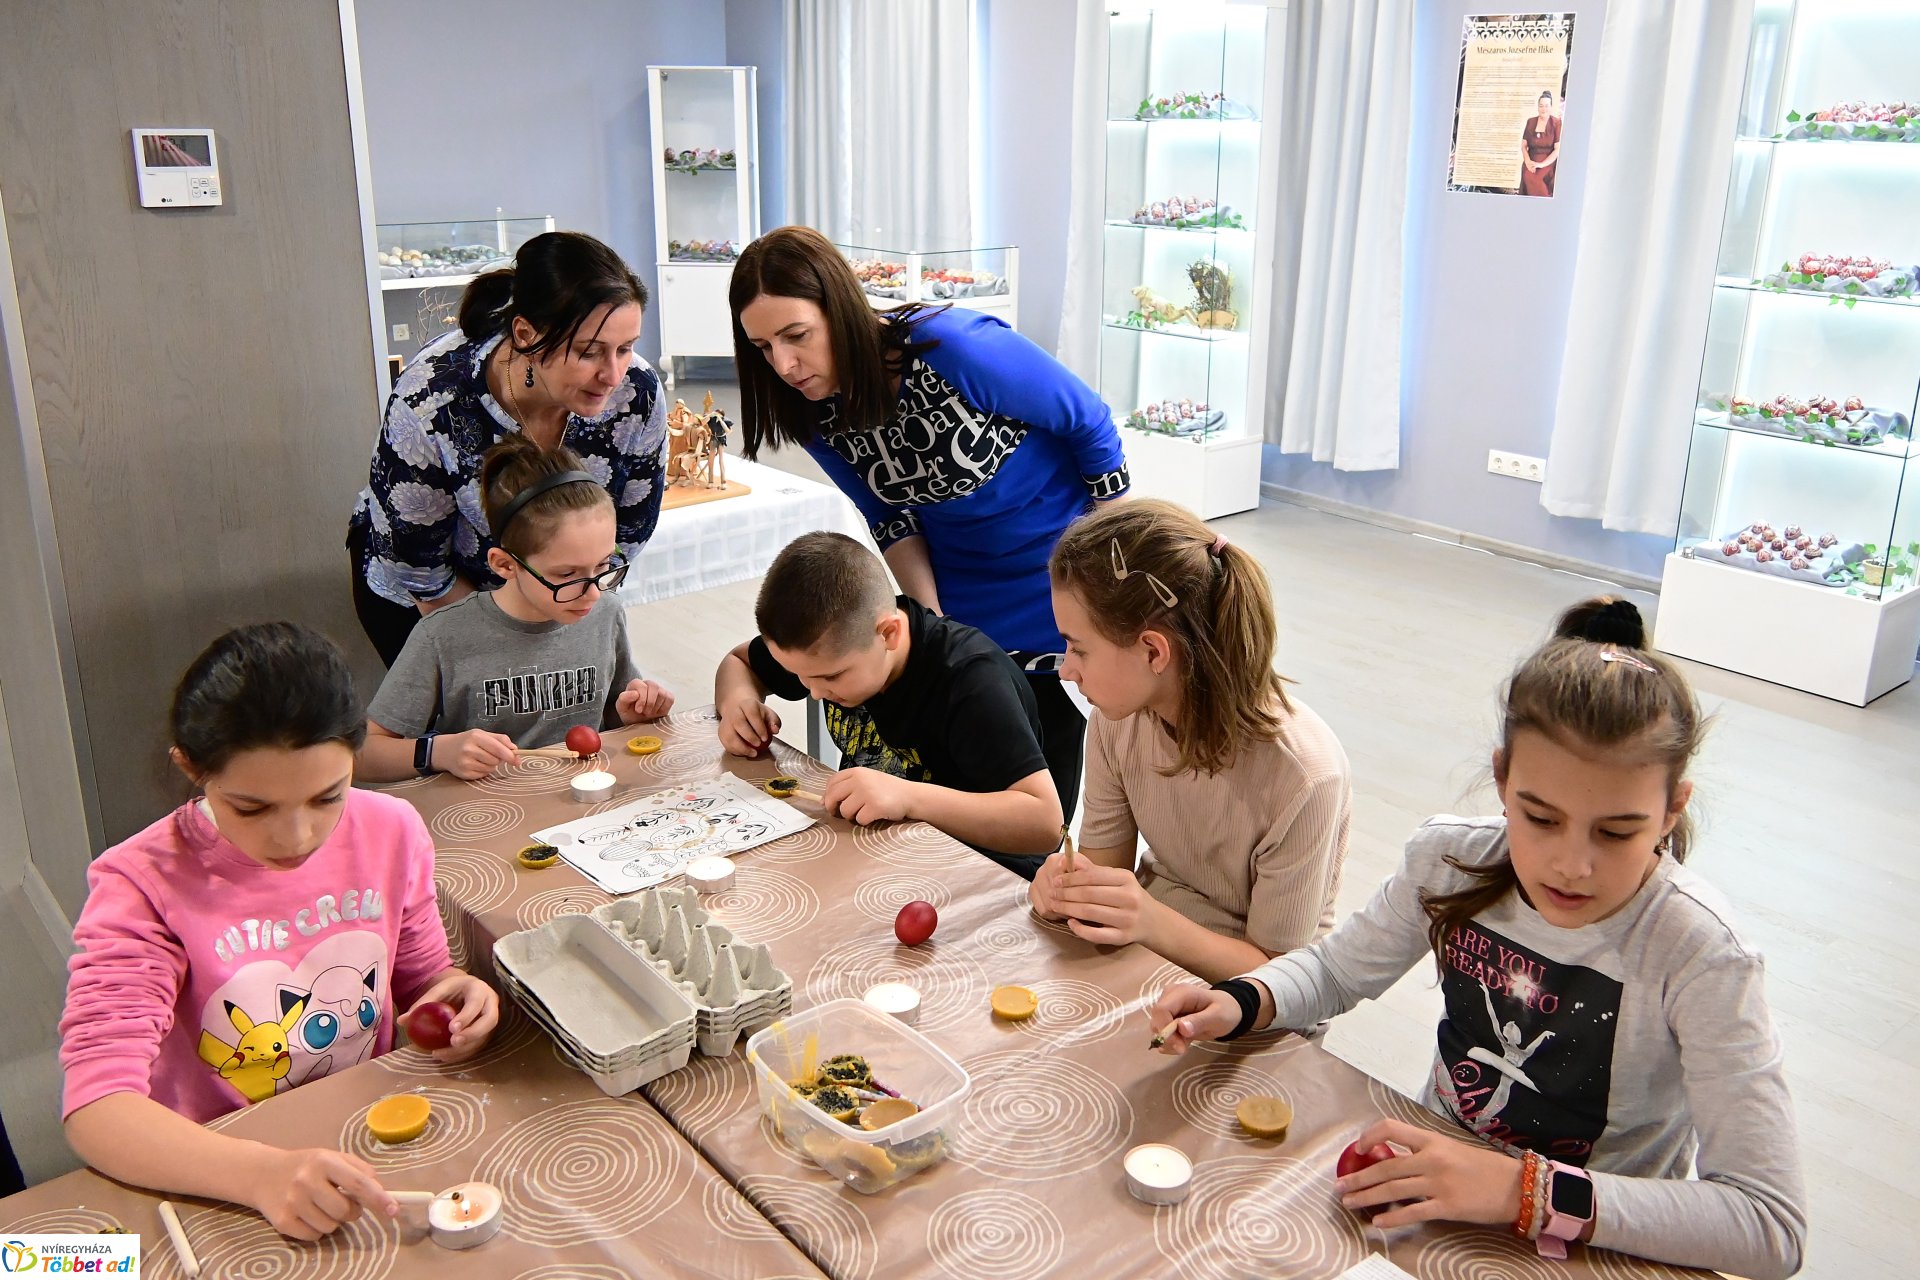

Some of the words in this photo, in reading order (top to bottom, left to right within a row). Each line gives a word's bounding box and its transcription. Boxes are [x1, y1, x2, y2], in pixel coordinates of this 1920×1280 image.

[483, 666, 597, 716] PUMA
[295, 888, 384, 937] CREW
[1445, 944, 1515, 997] READY
[1523, 985, 1559, 1015] TO
[1448, 927, 1492, 959] ARE
[1498, 945, 1547, 985] YOU
